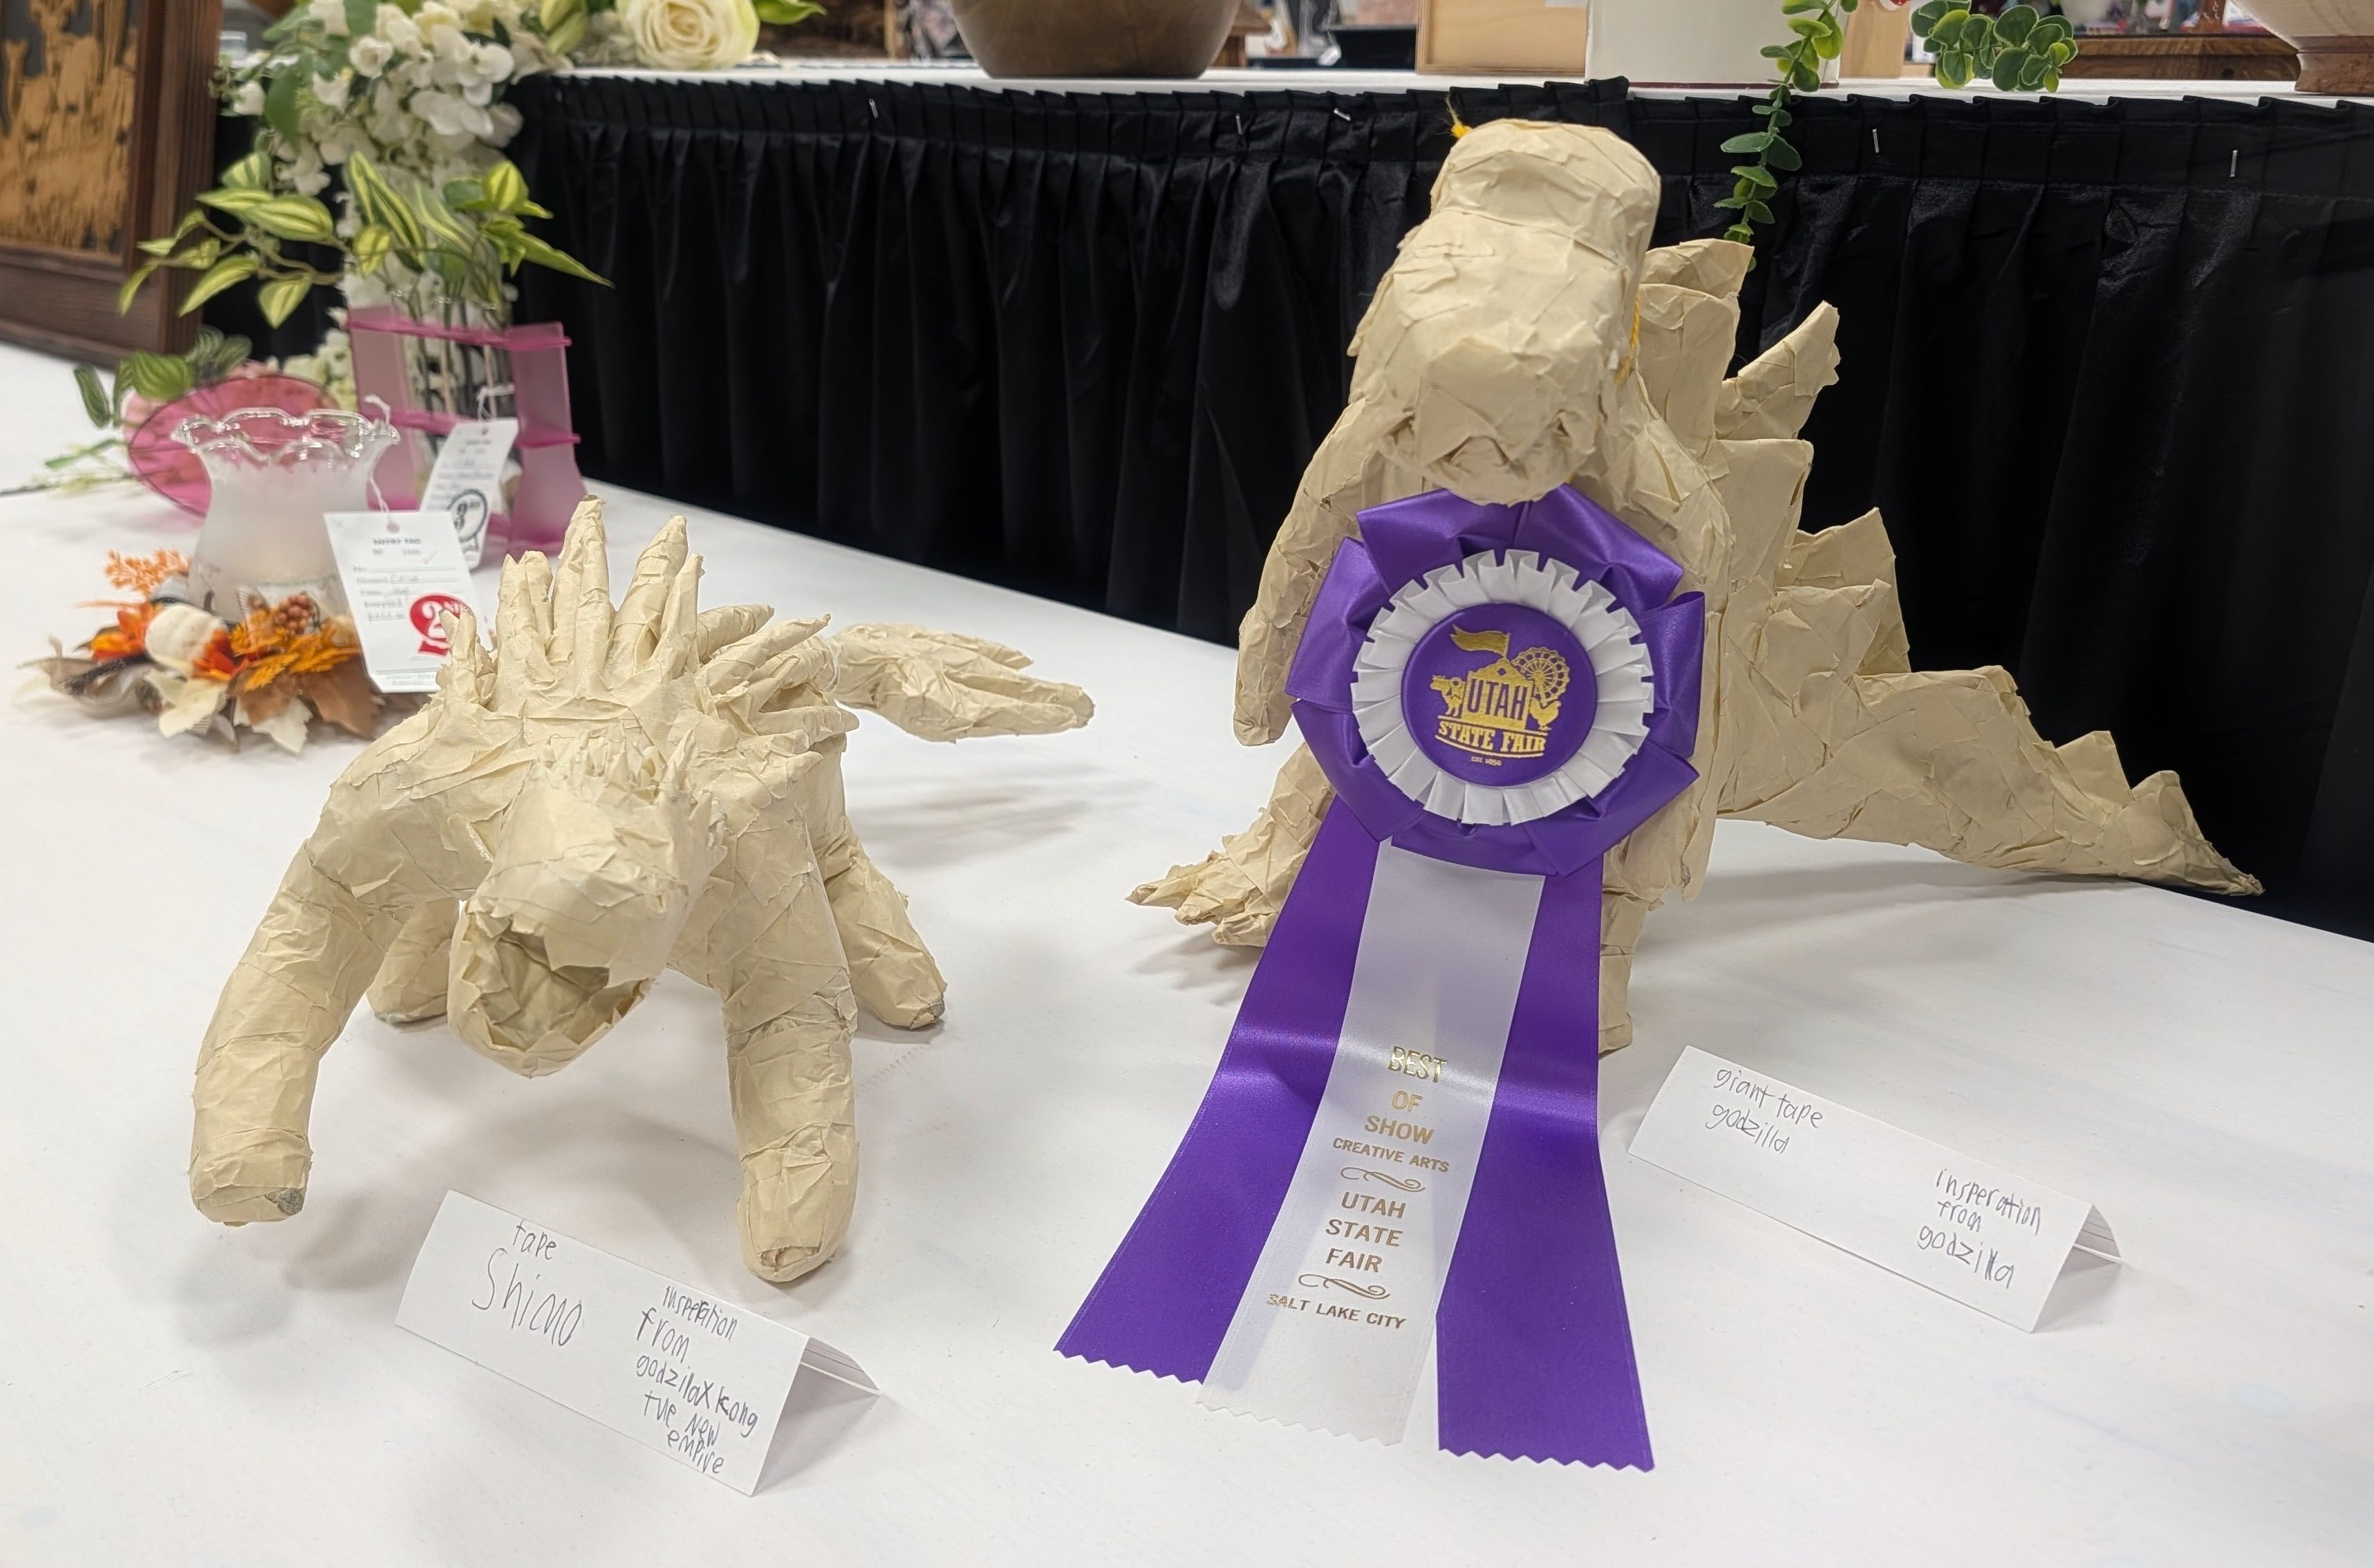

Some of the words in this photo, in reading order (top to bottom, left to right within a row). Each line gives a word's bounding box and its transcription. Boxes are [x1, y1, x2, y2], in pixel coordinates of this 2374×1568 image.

[1466, 678, 1529, 721] UTAH
[1438, 720, 1496, 751] STATE
[1500, 731, 1546, 753] FAIR
[1387, 1045, 1448, 1083] BEST
[1392, 1090, 1423, 1112] OF
[1713, 1067, 1775, 1108] giant
[1778, 1093, 1823, 1128] tape
[1364, 1115, 1434, 1144] SHOW
[1705, 1104, 1790, 1154] godzilla
[1333, 1137, 1405, 1163] CREATIVE
[1409, 1154, 1450, 1173] ARTS
[1341, 1191, 1406, 1218] UTAH
[512, 1218, 557, 1260] tape
[1325, 1219, 1403, 1247] STATE
[1325, 1248, 1383, 1273] FAIR
[1917, 1226, 2015, 1289] godzilla
[1266, 1294, 1311, 1312] SALT
[1316, 1303, 1361, 1322] LAKE
[1366, 1312, 1407, 1329] CITY
